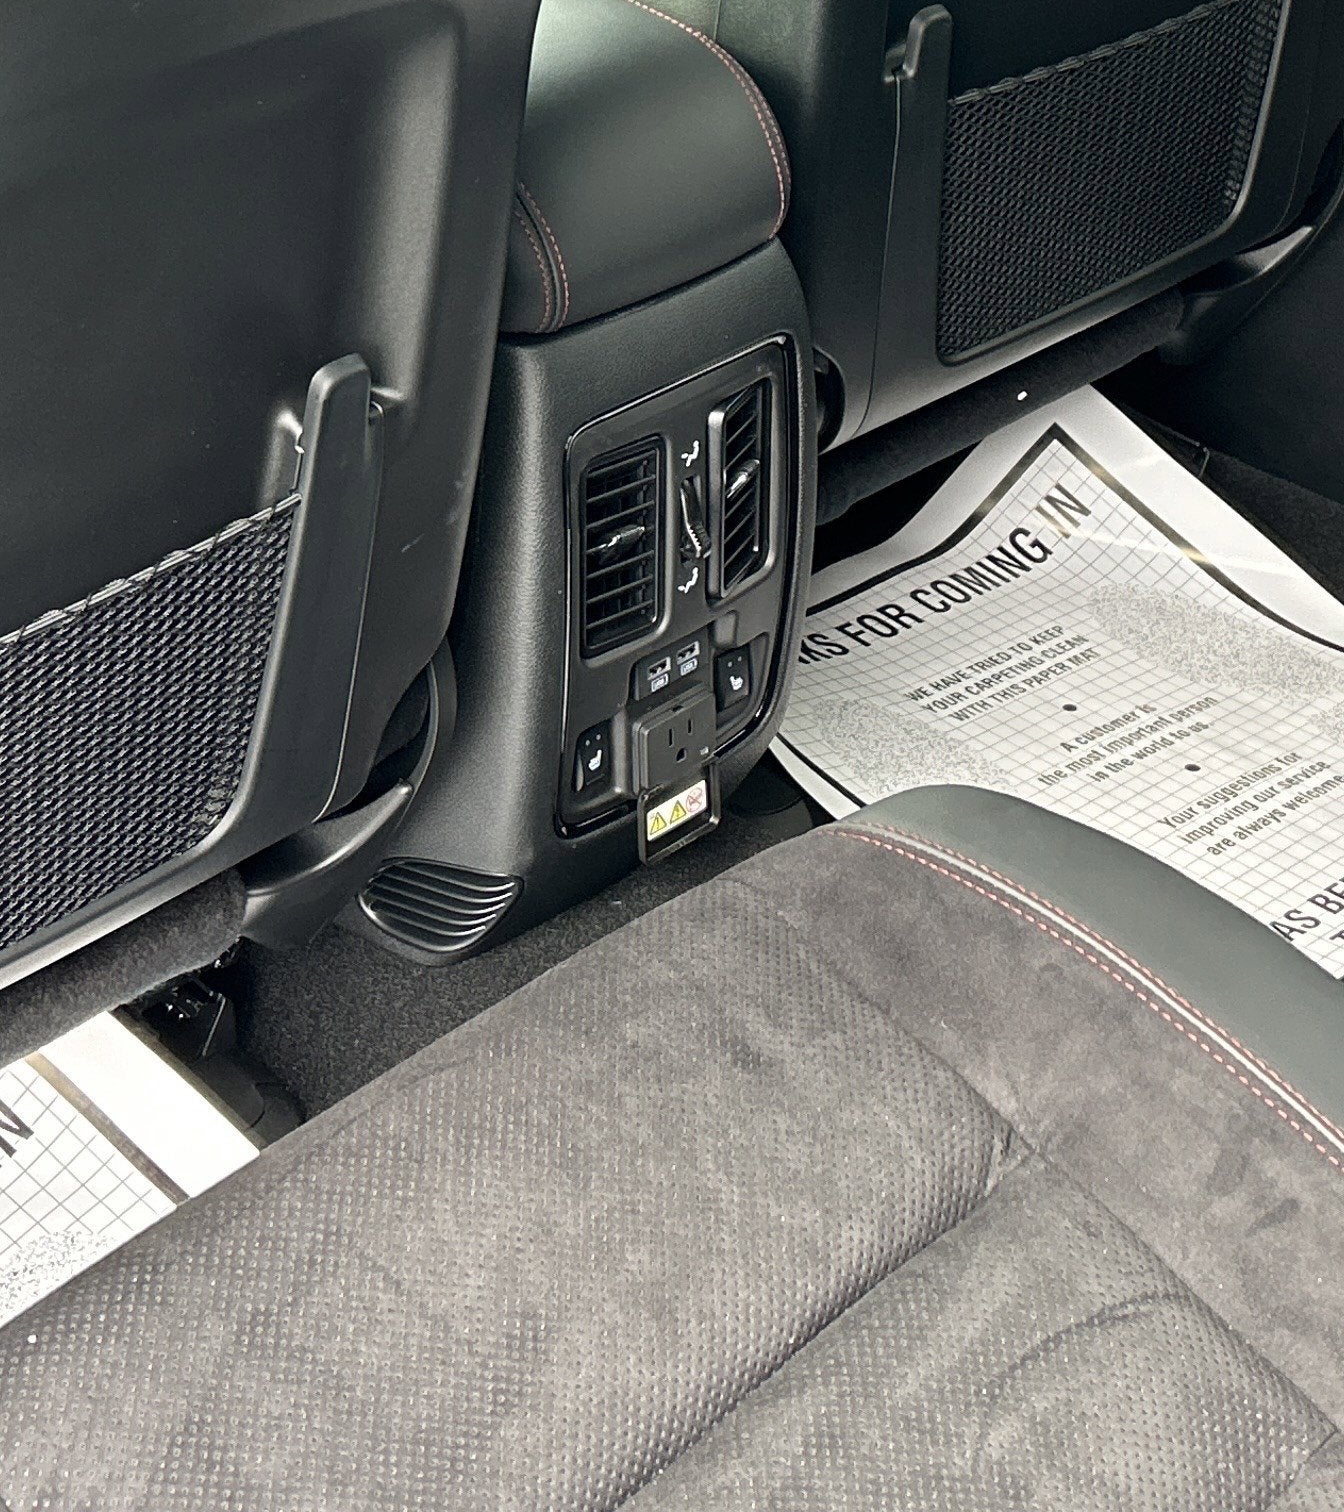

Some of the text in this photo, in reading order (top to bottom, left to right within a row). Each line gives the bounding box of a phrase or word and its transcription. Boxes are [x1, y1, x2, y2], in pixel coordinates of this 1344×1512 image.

[835, 603, 925, 648] FOR
[909, 527, 1053, 614] COMING
[1036, 483, 1092, 539] IN
[905, 625, 1065, 702] WE HAVE TRIED TO KEEP
[921, 635, 1090, 714] YOUR CARPETING CLEAN
[948, 647, 1102, 722] WITH THIS PAPER MAT
[1037, 696, 1218, 786] the most important person
[1060, 703, 1157, 753] A customer is
[1086, 769, 1110, 783] in
[1104, 757, 1134, 774] the
[1130, 735, 1175, 760] world
[1168, 728, 1191, 740] to
[1157, 751, 1304, 829] Your suggestions for
[1177, 760, 1331, 845] improving our service
[1206, 836, 1236, 856] are
[1233, 807, 1287, 840] always
